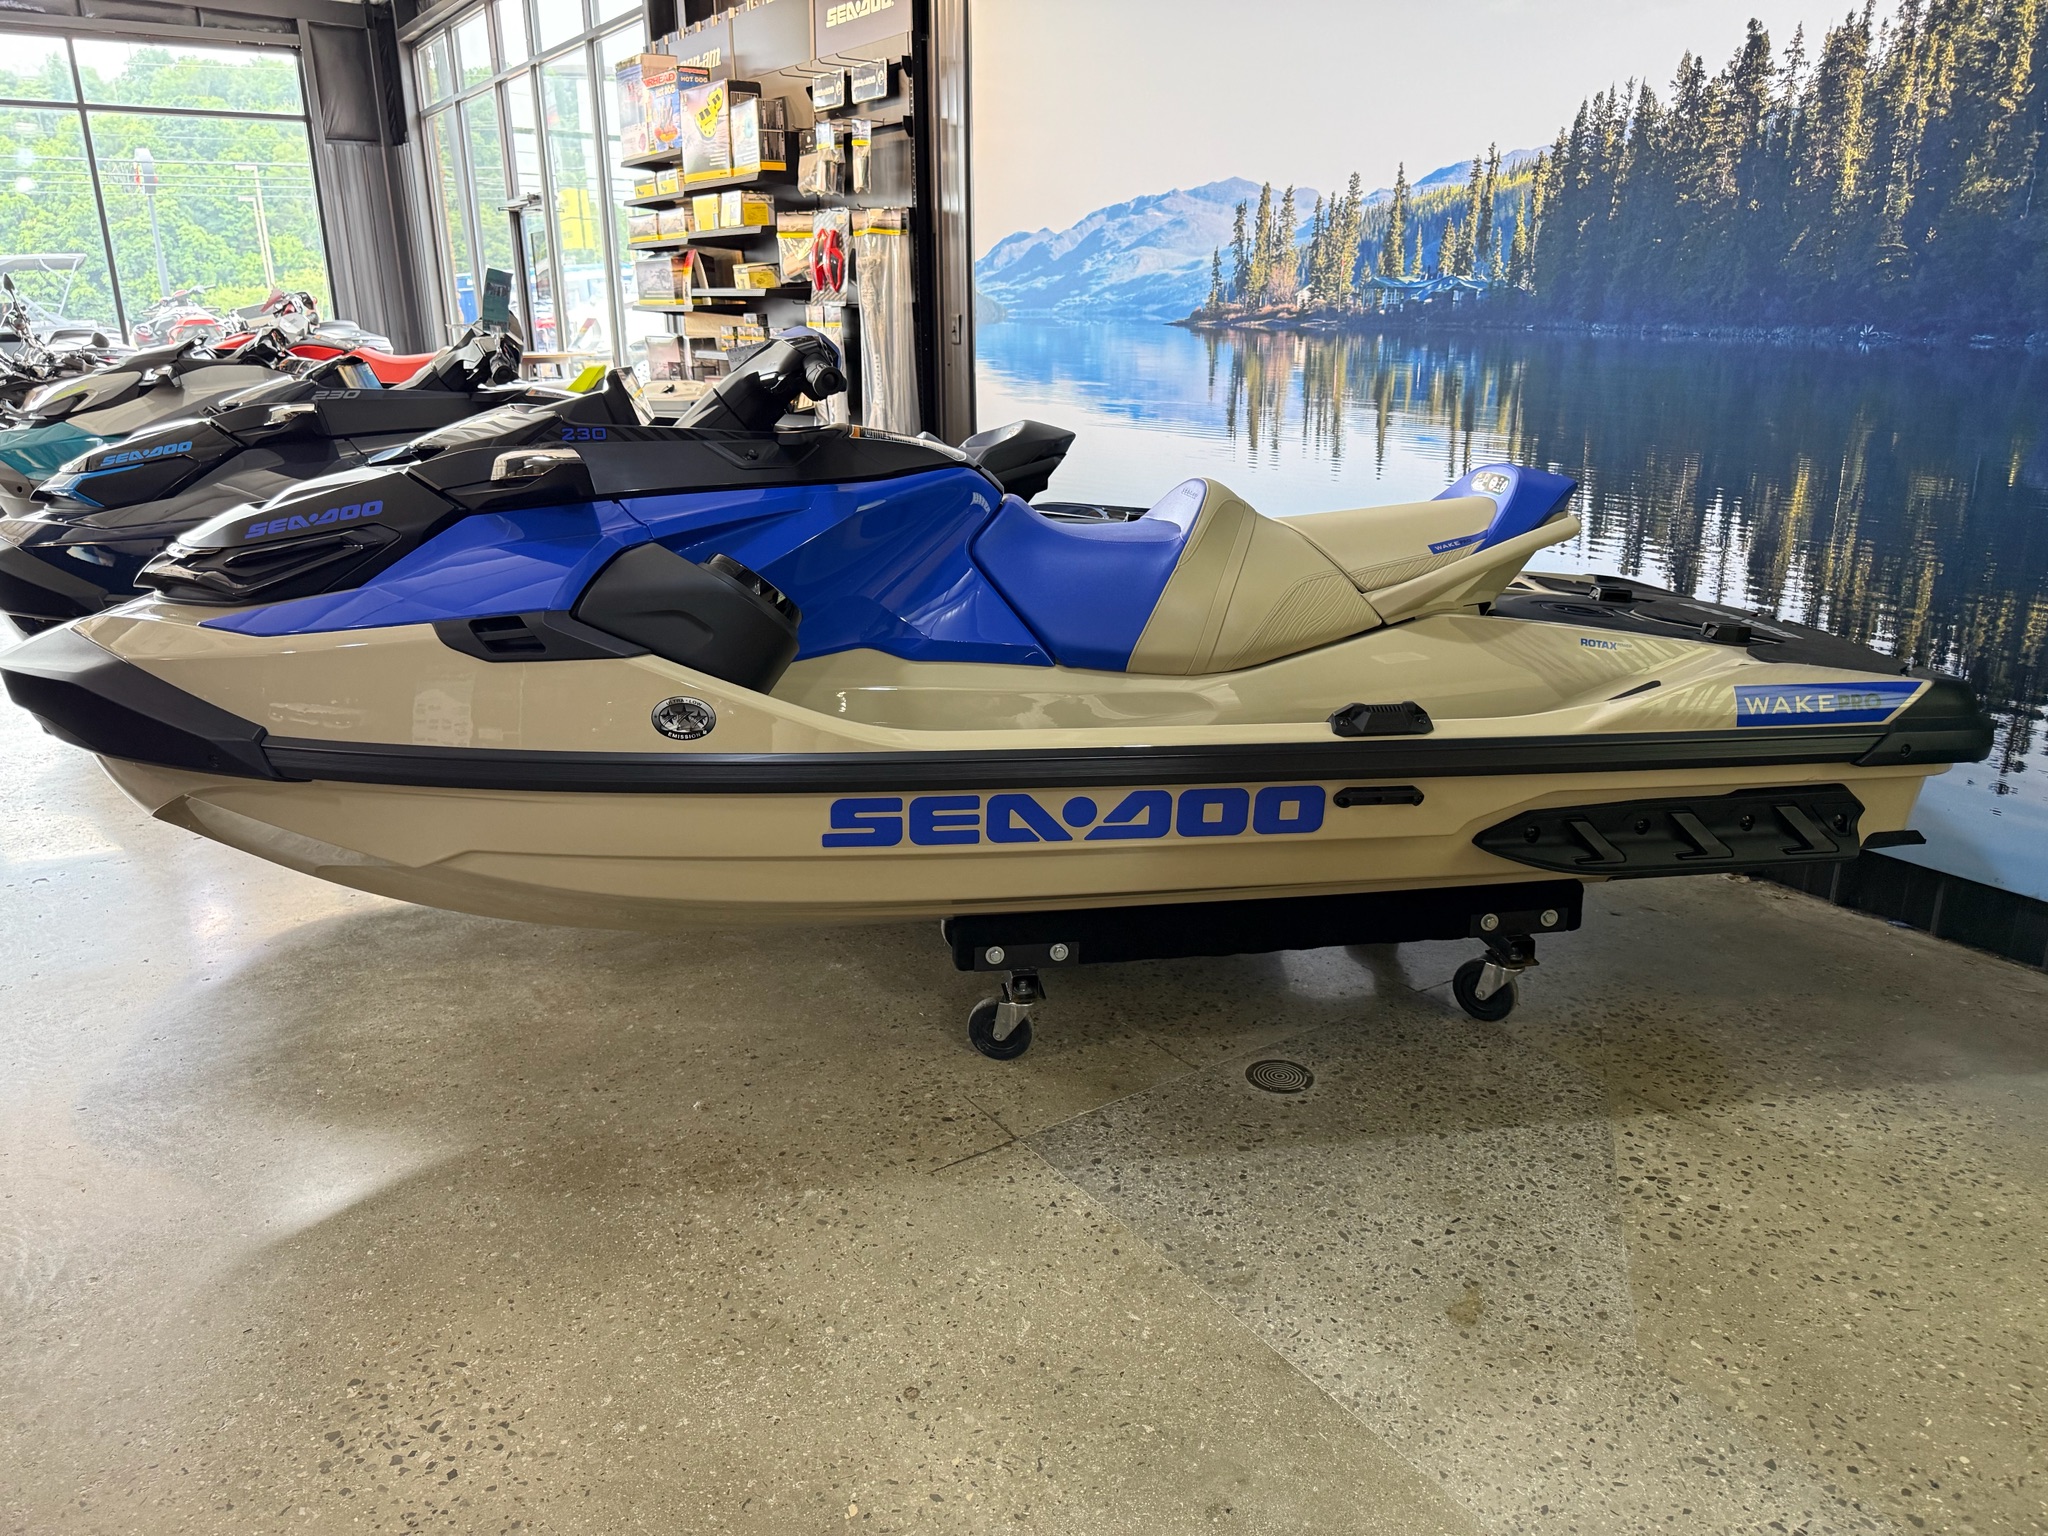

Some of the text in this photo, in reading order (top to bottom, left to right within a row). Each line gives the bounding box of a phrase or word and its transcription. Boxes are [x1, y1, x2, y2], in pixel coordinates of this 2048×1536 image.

[311, 390, 361, 400] 230
[561, 427, 607, 440] 230
[1580, 638, 1618, 650] ROTAX
[667, 731, 701, 739] EMISSION
